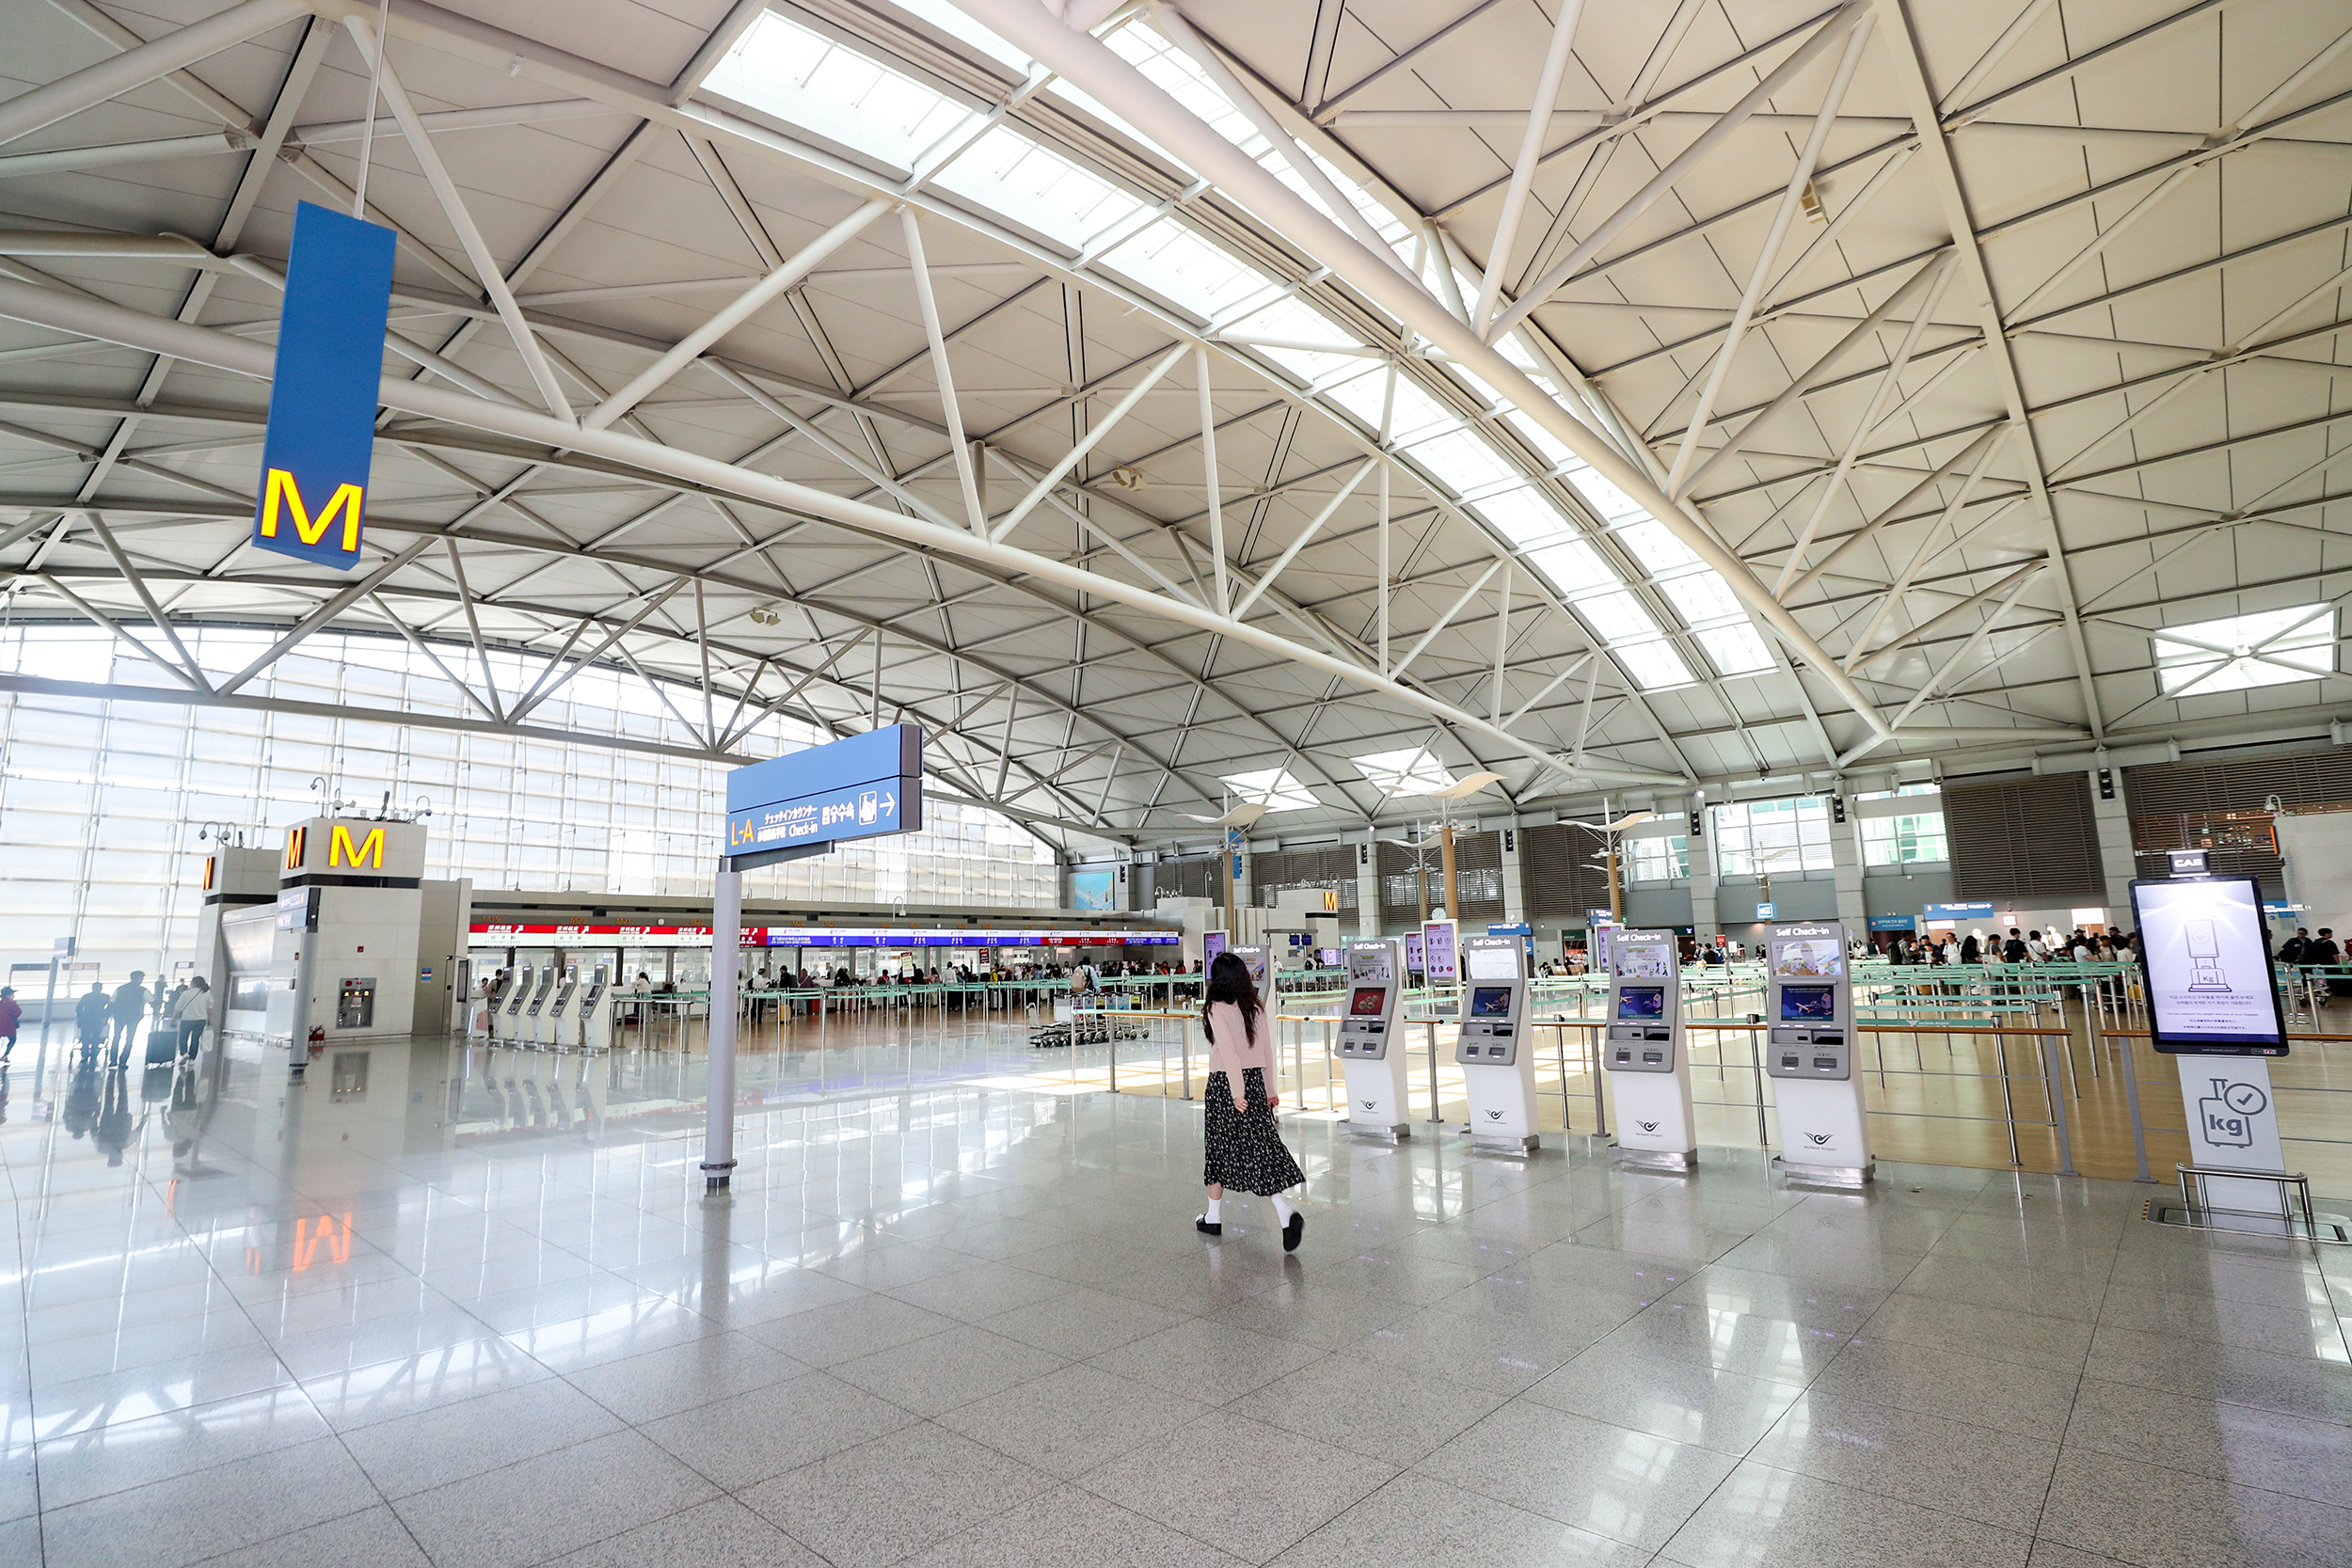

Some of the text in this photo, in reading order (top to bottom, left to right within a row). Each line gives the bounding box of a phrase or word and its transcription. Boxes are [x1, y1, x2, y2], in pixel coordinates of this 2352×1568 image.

[260, 467, 363, 552] M
[821, 800, 856, 826] 탑승수속
[731, 818, 755, 847] L-A
[788, 820, 818, 838] Check-in
[285, 826, 306, 870] M
[328, 825, 386, 869] M
[2173, 858, 2203, 868] CAS
[1323, 892, 1338, 911] M
[1484, 938, 1511, 946] Check-in
[1616, 933, 1662, 942] Self Check-in
[1775, 927, 1830, 937] Self Check-in
[2209, 1114, 2243, 1136] kg
